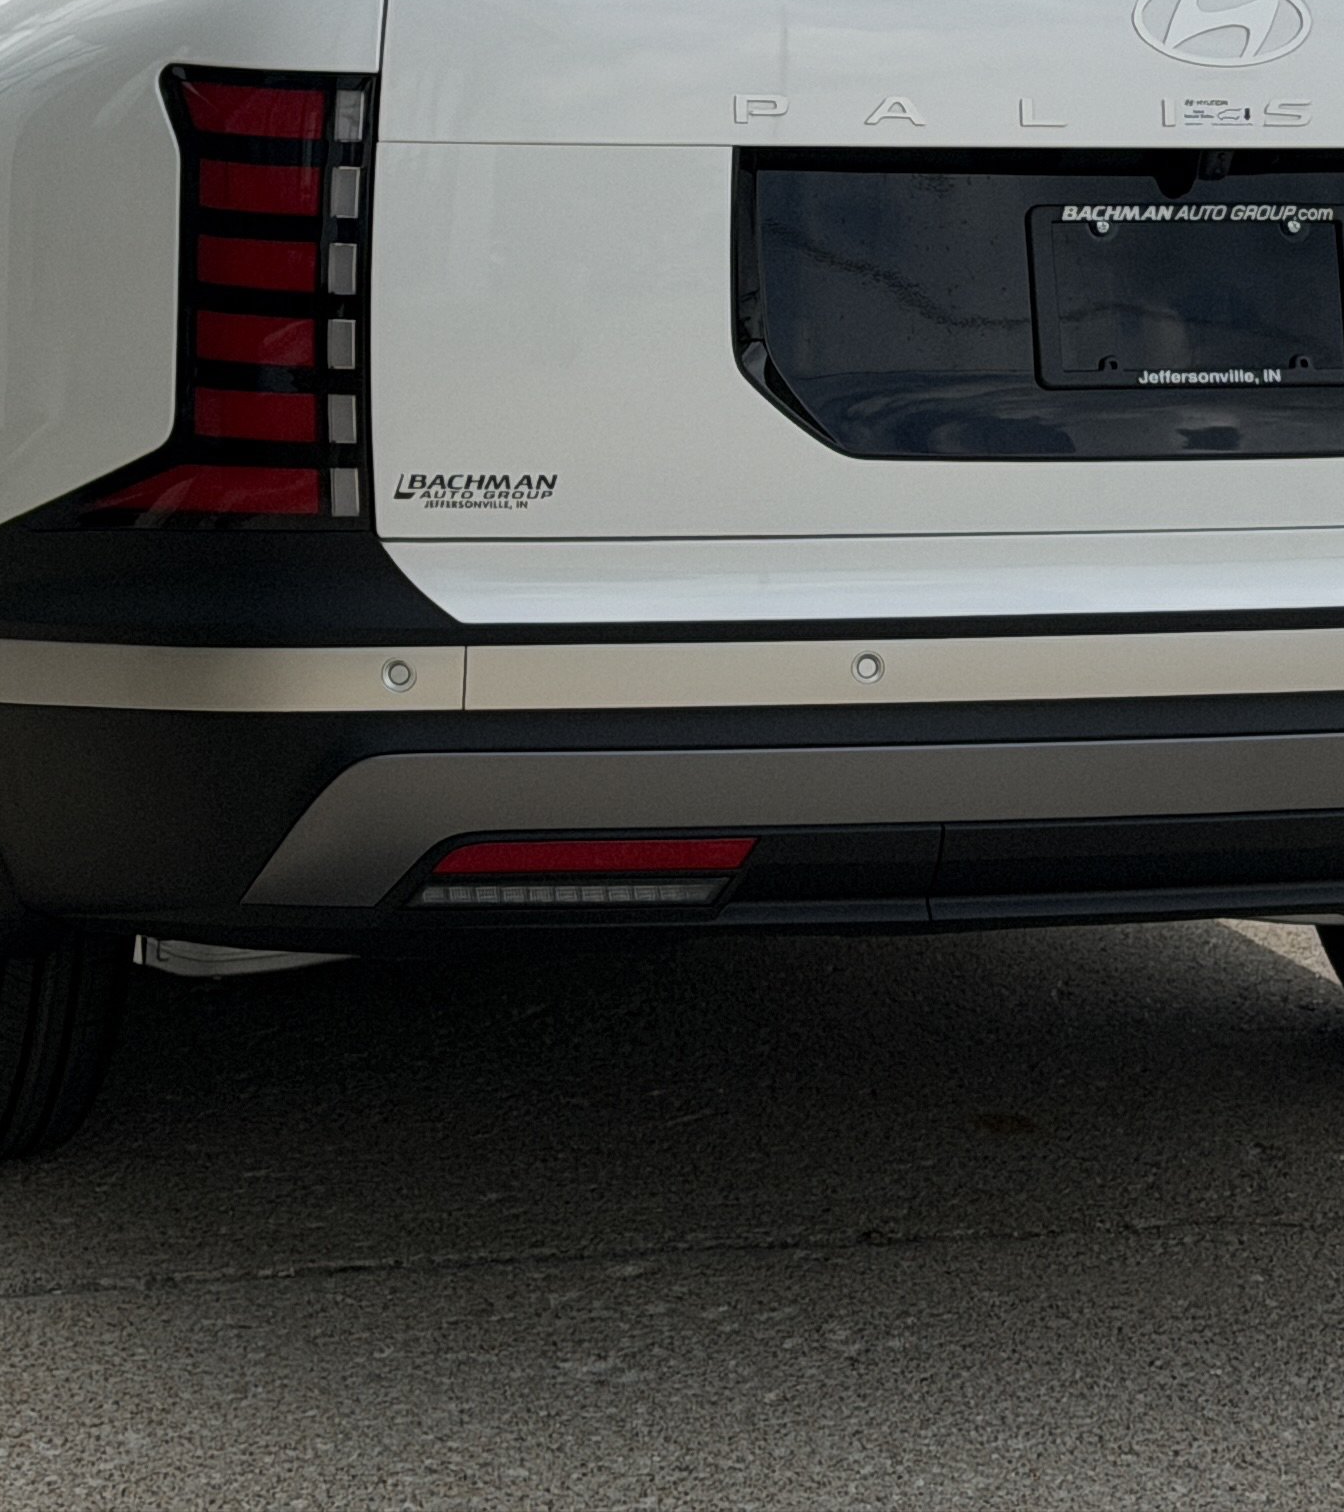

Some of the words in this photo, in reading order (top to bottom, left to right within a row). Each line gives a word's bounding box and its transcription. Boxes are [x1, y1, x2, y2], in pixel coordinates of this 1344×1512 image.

[1061, 205, 1174, 221] BACHMAN
[1174, 205, 1227, 221] AUTO
[1230, 204, 1334, 221] GROUP.com
[1138, 368, 1260, 385] Jeffersonville,
[1263, 369, 1282, 383] IN
[407, 473, 558, 490] BACHMAN
[419, 490, 474, 500] AUTO
[482, 490, 554, 500] GROUP
[424, 500, 513, 510] JEFFERSONVILLE,
[515, 500, 529, 509] IN
